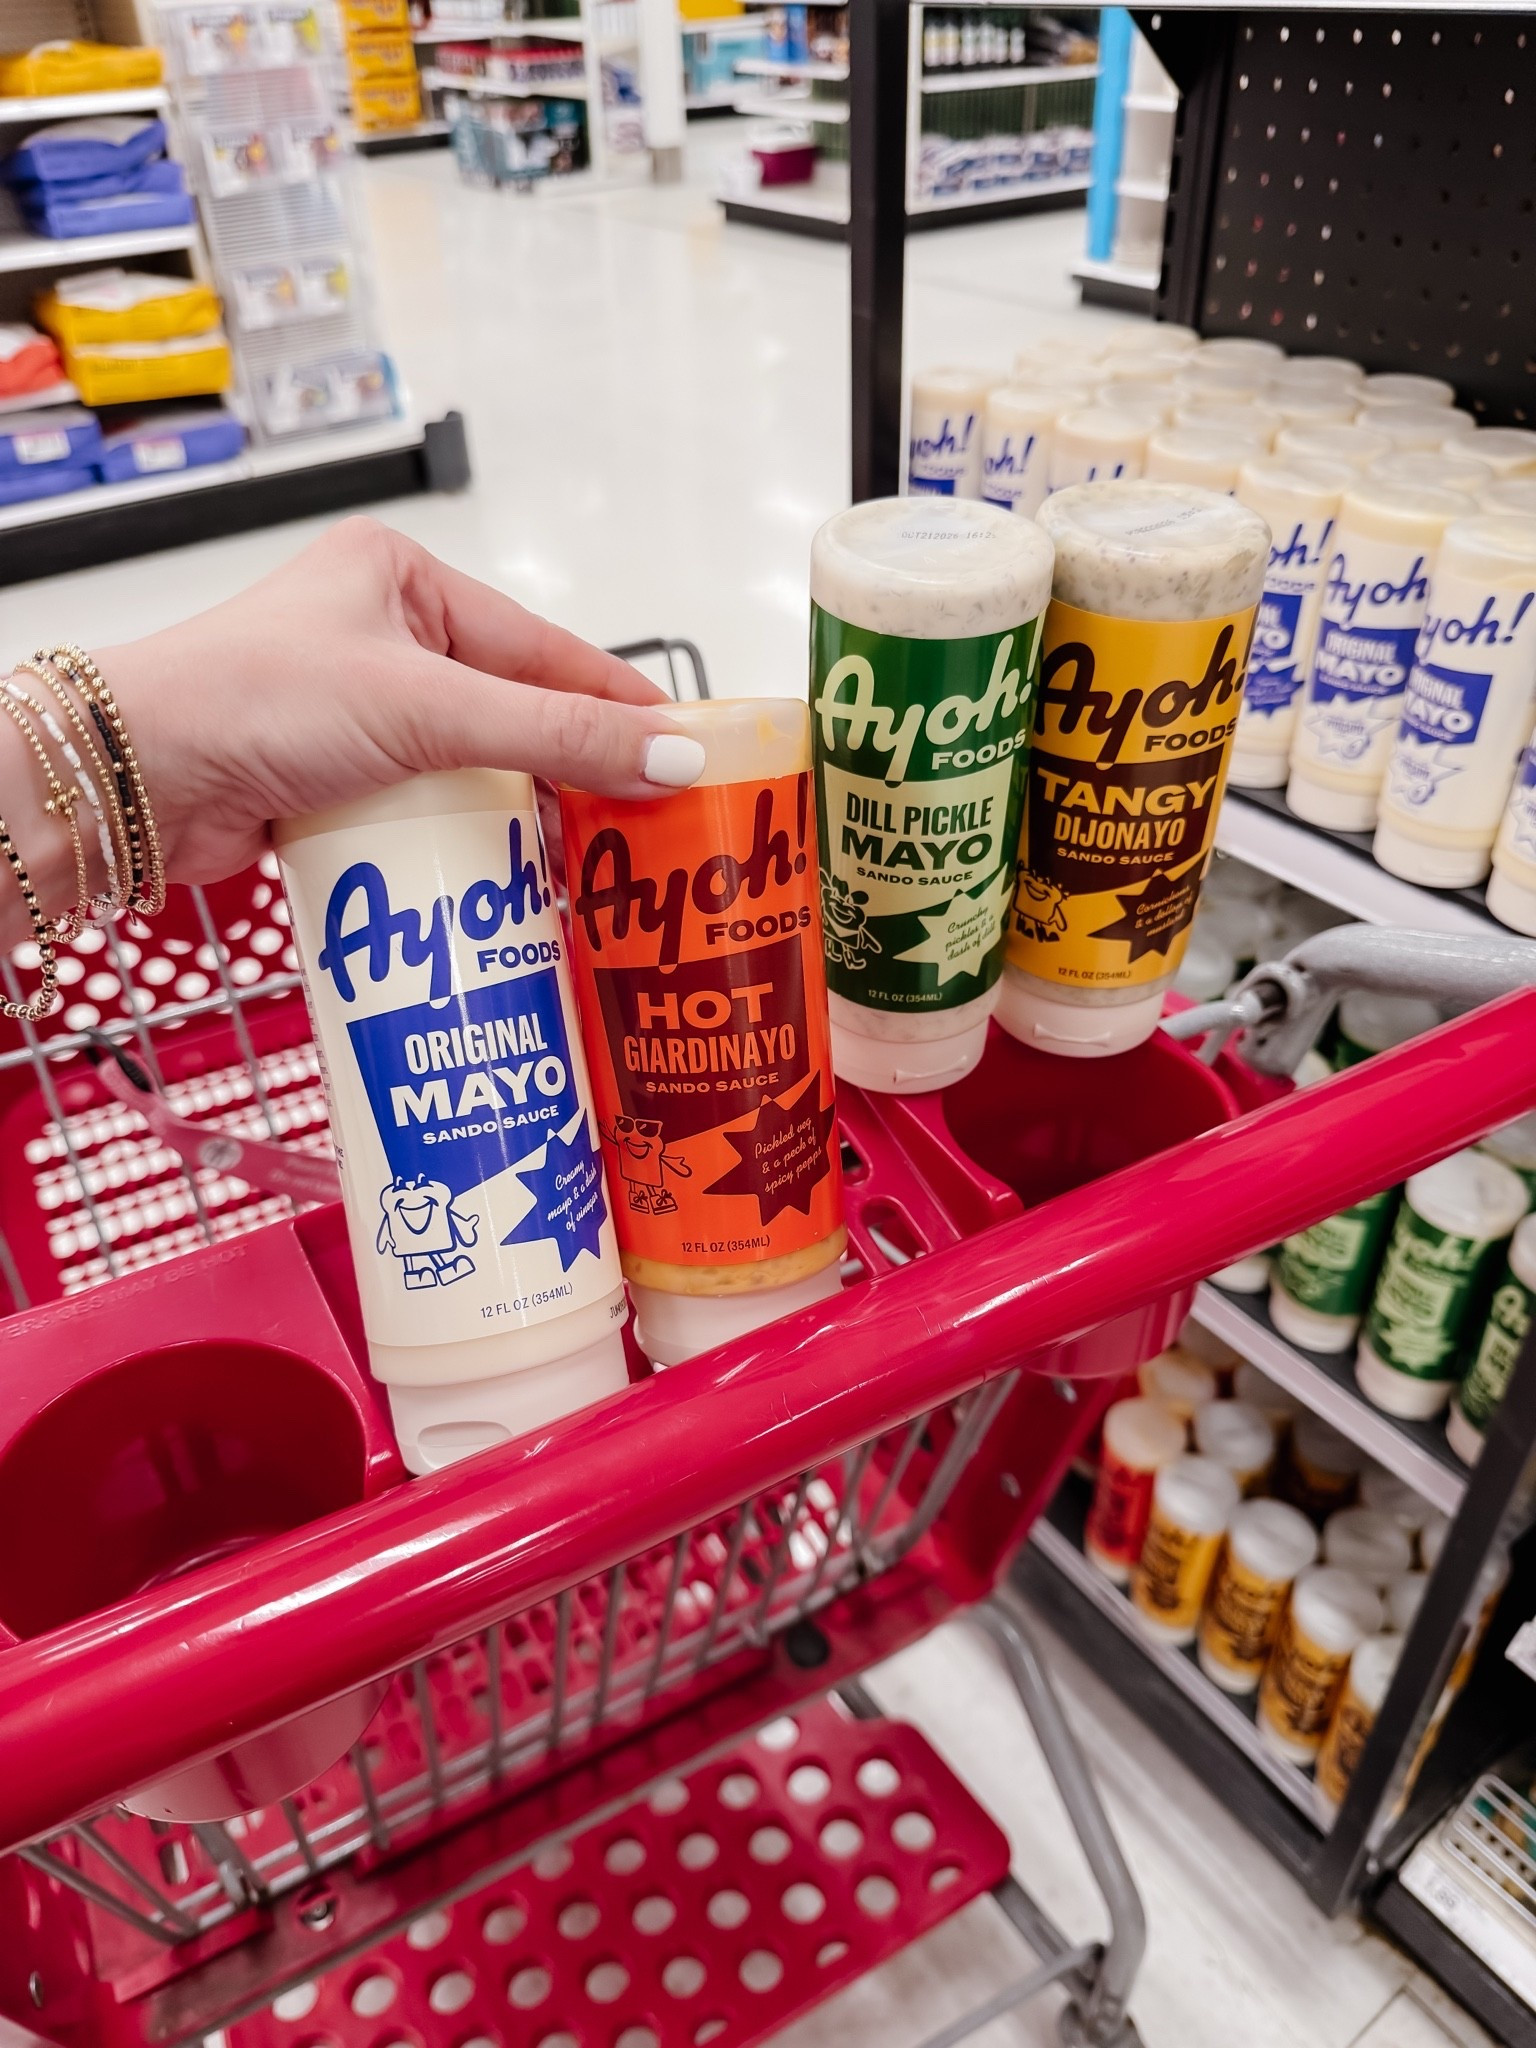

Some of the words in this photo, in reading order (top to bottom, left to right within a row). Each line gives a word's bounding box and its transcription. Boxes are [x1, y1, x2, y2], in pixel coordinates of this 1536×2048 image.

[1034, 602, 1258, 770] Ayoh!
[1315, 651, 1406, 687] MAYO
[815, 606, 1047, 788] Ayoh!
[931, 728, 1027, 770] FOODS
[1144, 717, 1238, 752] FOODS
[1037, 766, 1218, 817] TANGY
[846, 791, 897, 834] DILL
[903, 796, 994, 836] PICKLE
[1053, 811, 1187, 851] DIJONAYO
[841, 824, 993, 871] MAYO
[1056, 847, 1115, 866] SANDO
[1119, 851, 1175, 866] SAUCE
[575, 772, 808, 975] Ayoh!
[857, 866, 914, 885] SANDO
[918, 871, 973, 886] SAUCE
[318, 817, 551, 1010] Ayoh!
[706, 905, 812, 946] FOODS
[947, 906, 989, 934] Crunchy
[477, 940, 561, 973] FOODS
[945, 928, 979, 953] pickles
[947, 942, 971, 961] dash
[972, 936, 981, 950] of
[1058, 967, 1067, 976] 12
[1069, 968, 1079, 978] FL
[1082, 970, 1094, 980] OZ
[637, 981, 774, 1030] HOT
[868, 989, 876, 998] 12
[879, 991, 889, 1000] FL
[892, 993, 904, 1002] OZ
[906, 992, 943, 1003] (354ML)
[404, 1012, 548, 1075] ORIGINAL
[623, 1023, 796, 1074] GIARDINAYO
[389, 1055, 567, 1128] MAYO
[646, 1080, 710, 1094] SANDO
[715, 1071, 780, 1092] SAUCE
[422, 1120, 499, 1145] SANDO
[503, 1104, 559, 1129] SAUCE
[754, 1123, 796, 1159] Pickled
[796, 1117, 812, 1134] veg
[761, 1161, 771, 1175] &
[773, 1160, 782, 1169] a
[783, 1138, 807, 1167] peck
[807, 1127, 817, 1147] of
[764, 1173, 794, 1195] spicy
[796, 1146, 822, 1178] pepps
[555, 1160, 586, 1191] Creamy
[547, 1193, 573, 1222] mayo
[573, 1186, 581, 1201] &
[580, 1184, 586, 1193] a
[566, 1211, 577, 1233] of
[575, 1191, 600, 1223] vinegar
[682, 1242, 692, 1253] 12
[695, 1242, 708, 1253] FL
[710, 1241, 725, 1253] OZ
[727, 1234, 771, 1253] (354ML)
[0, 1295, 106, 1341] ERAGES
[481, 1306, 493, 1319] 12
[496, 1304, 511, 1316] FL
[513, 1297, 530, 1312] OZ
[531, 1281, 574, 1308] (354ML)
